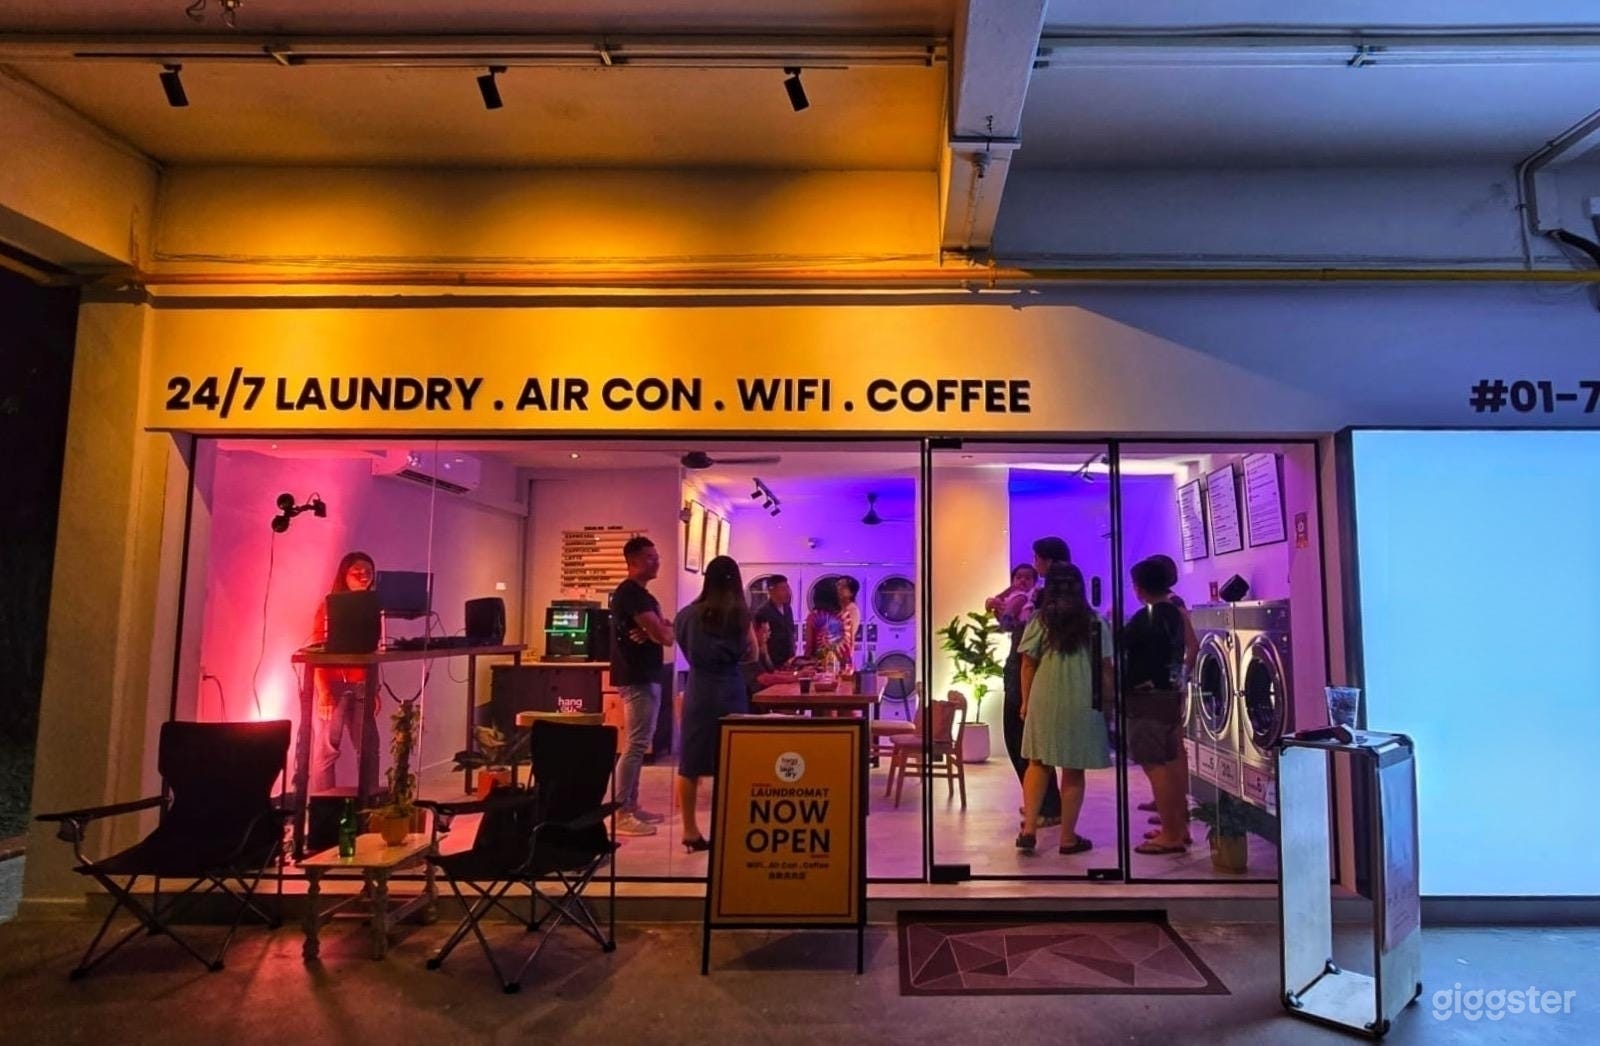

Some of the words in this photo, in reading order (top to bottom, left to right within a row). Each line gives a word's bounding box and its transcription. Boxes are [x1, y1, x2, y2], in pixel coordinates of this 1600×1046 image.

[166, 367, 265, 418] 24/7
[276, 377, 483, 411] LAUNDRY
[516, 378, 589, 411] AIR
[602, 378, 701, 411] CON
[737, 378, 830, 412] WIFI
[867, 379, 1031, 413] COFFEE
[558, 696, 583, 709] hang
[751, 787, 830, 798] LAUNDROMAT
[750, 800, 830, 824] NOW
[745, 829, 831, 854] OPEN
